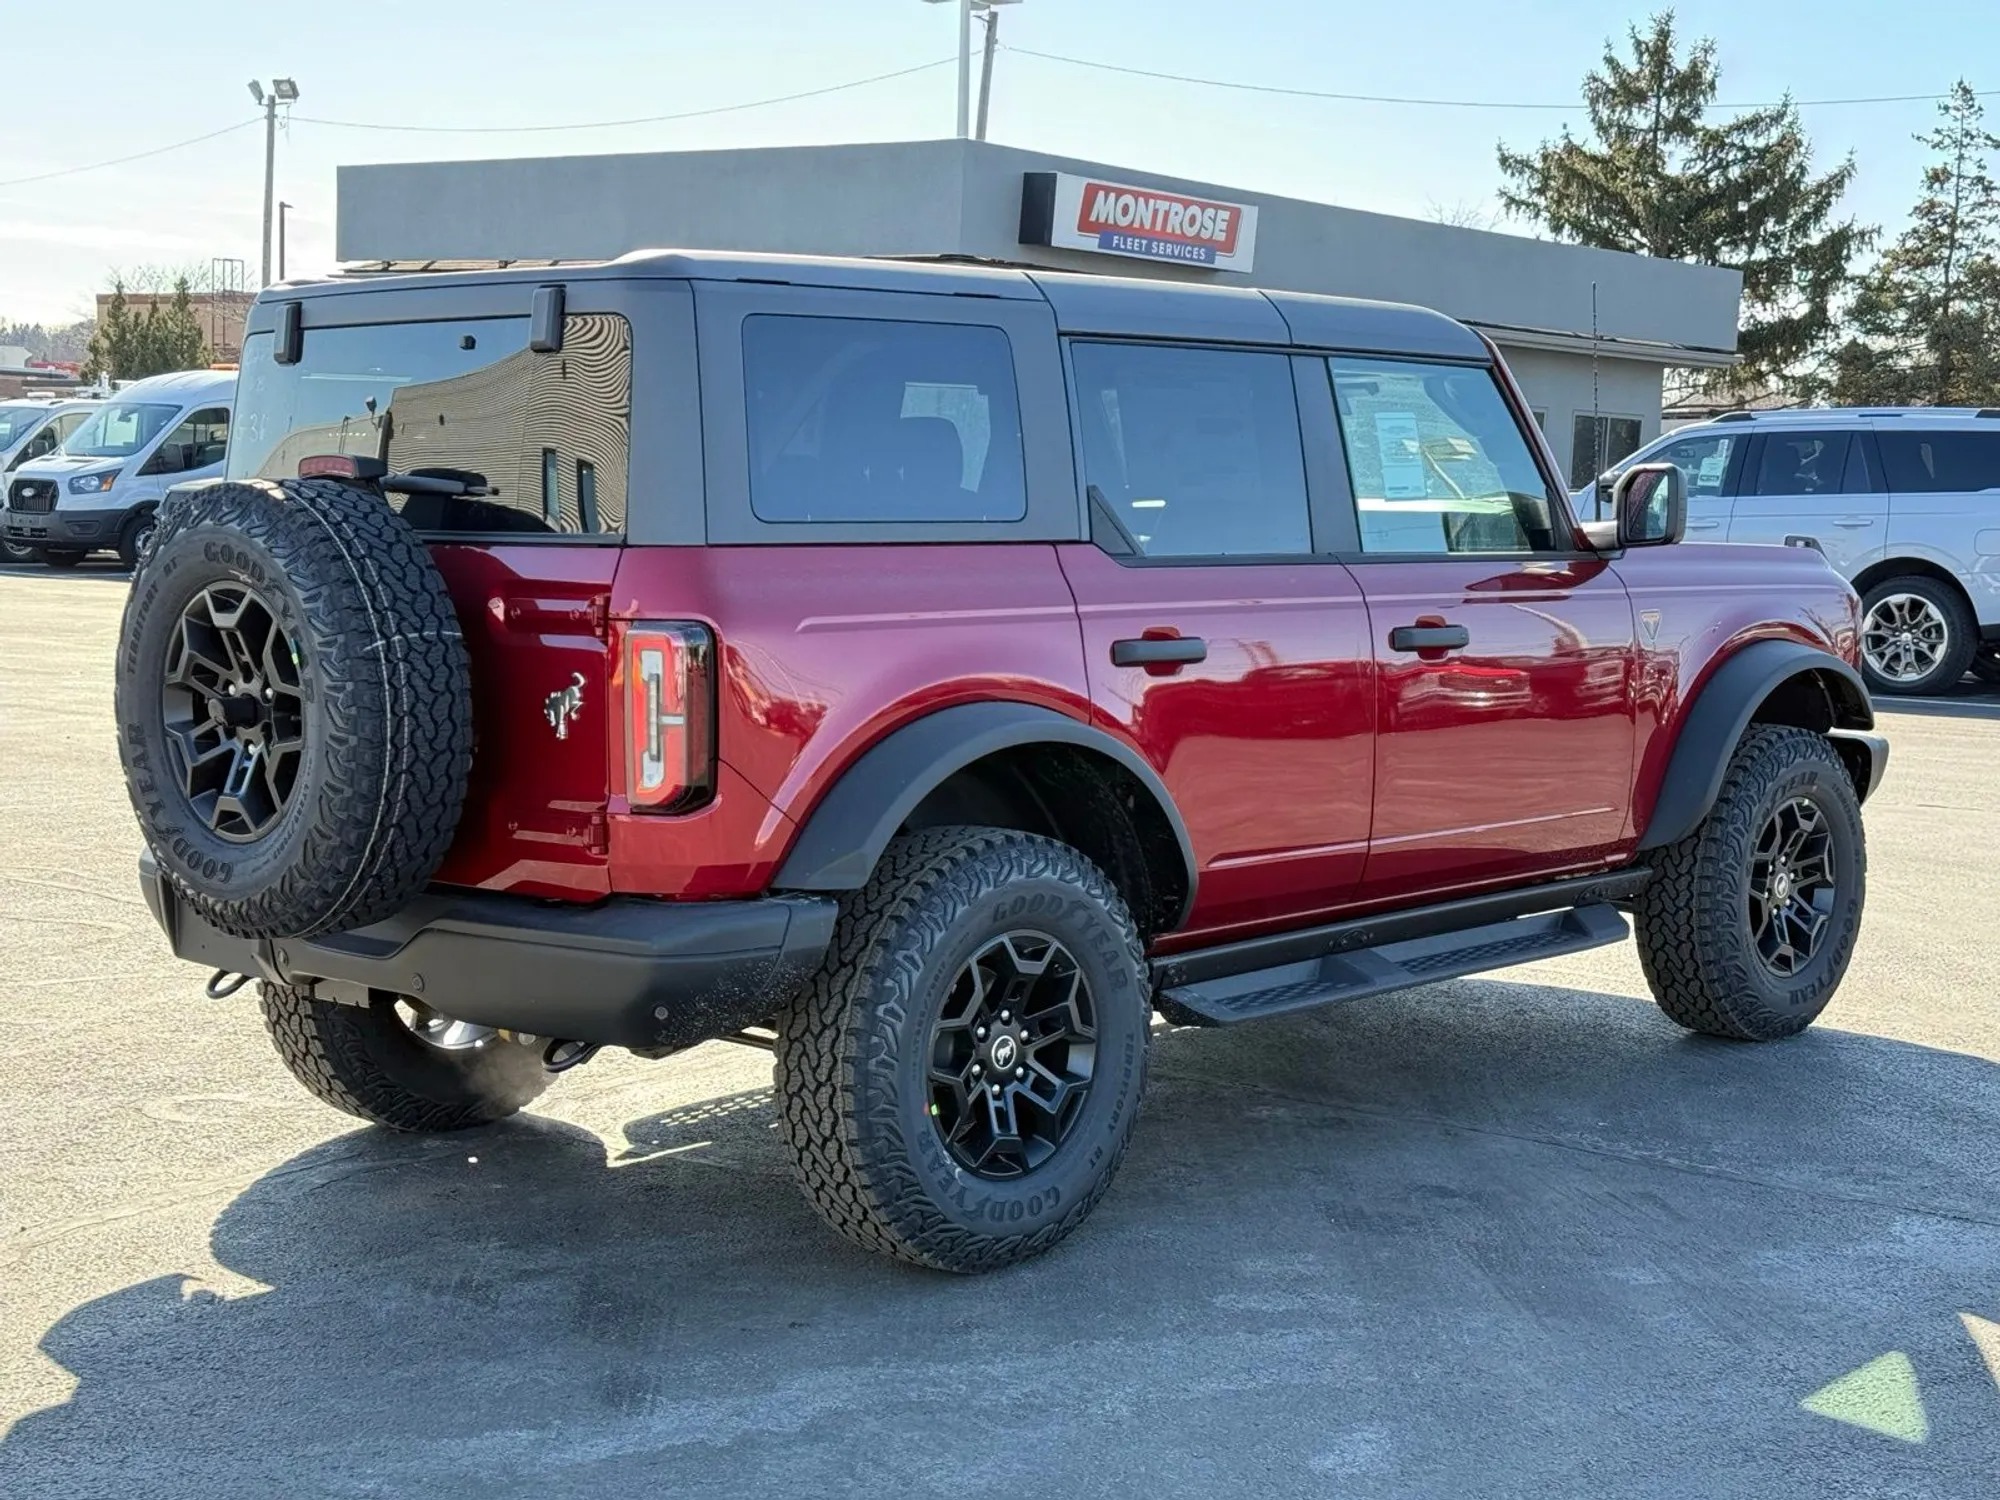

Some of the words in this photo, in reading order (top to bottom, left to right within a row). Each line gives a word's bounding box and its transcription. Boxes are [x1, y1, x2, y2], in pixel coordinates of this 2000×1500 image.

[1089, 190, 1230, 242] MONTROSE
[1113, 235, 1146, 254] FLEET
[1152, 241, 1206, 260] SERVICES
[127, 580, 160, 675] TERRITORY
[127, 722, 234, 884] GOODYEAR
[992, 892, 1128, 992] GOODYEAR
[1108, 1032, 1135, 1135] TERRITORY
[917, 1130, 1061, 1223] GOODYEAR
